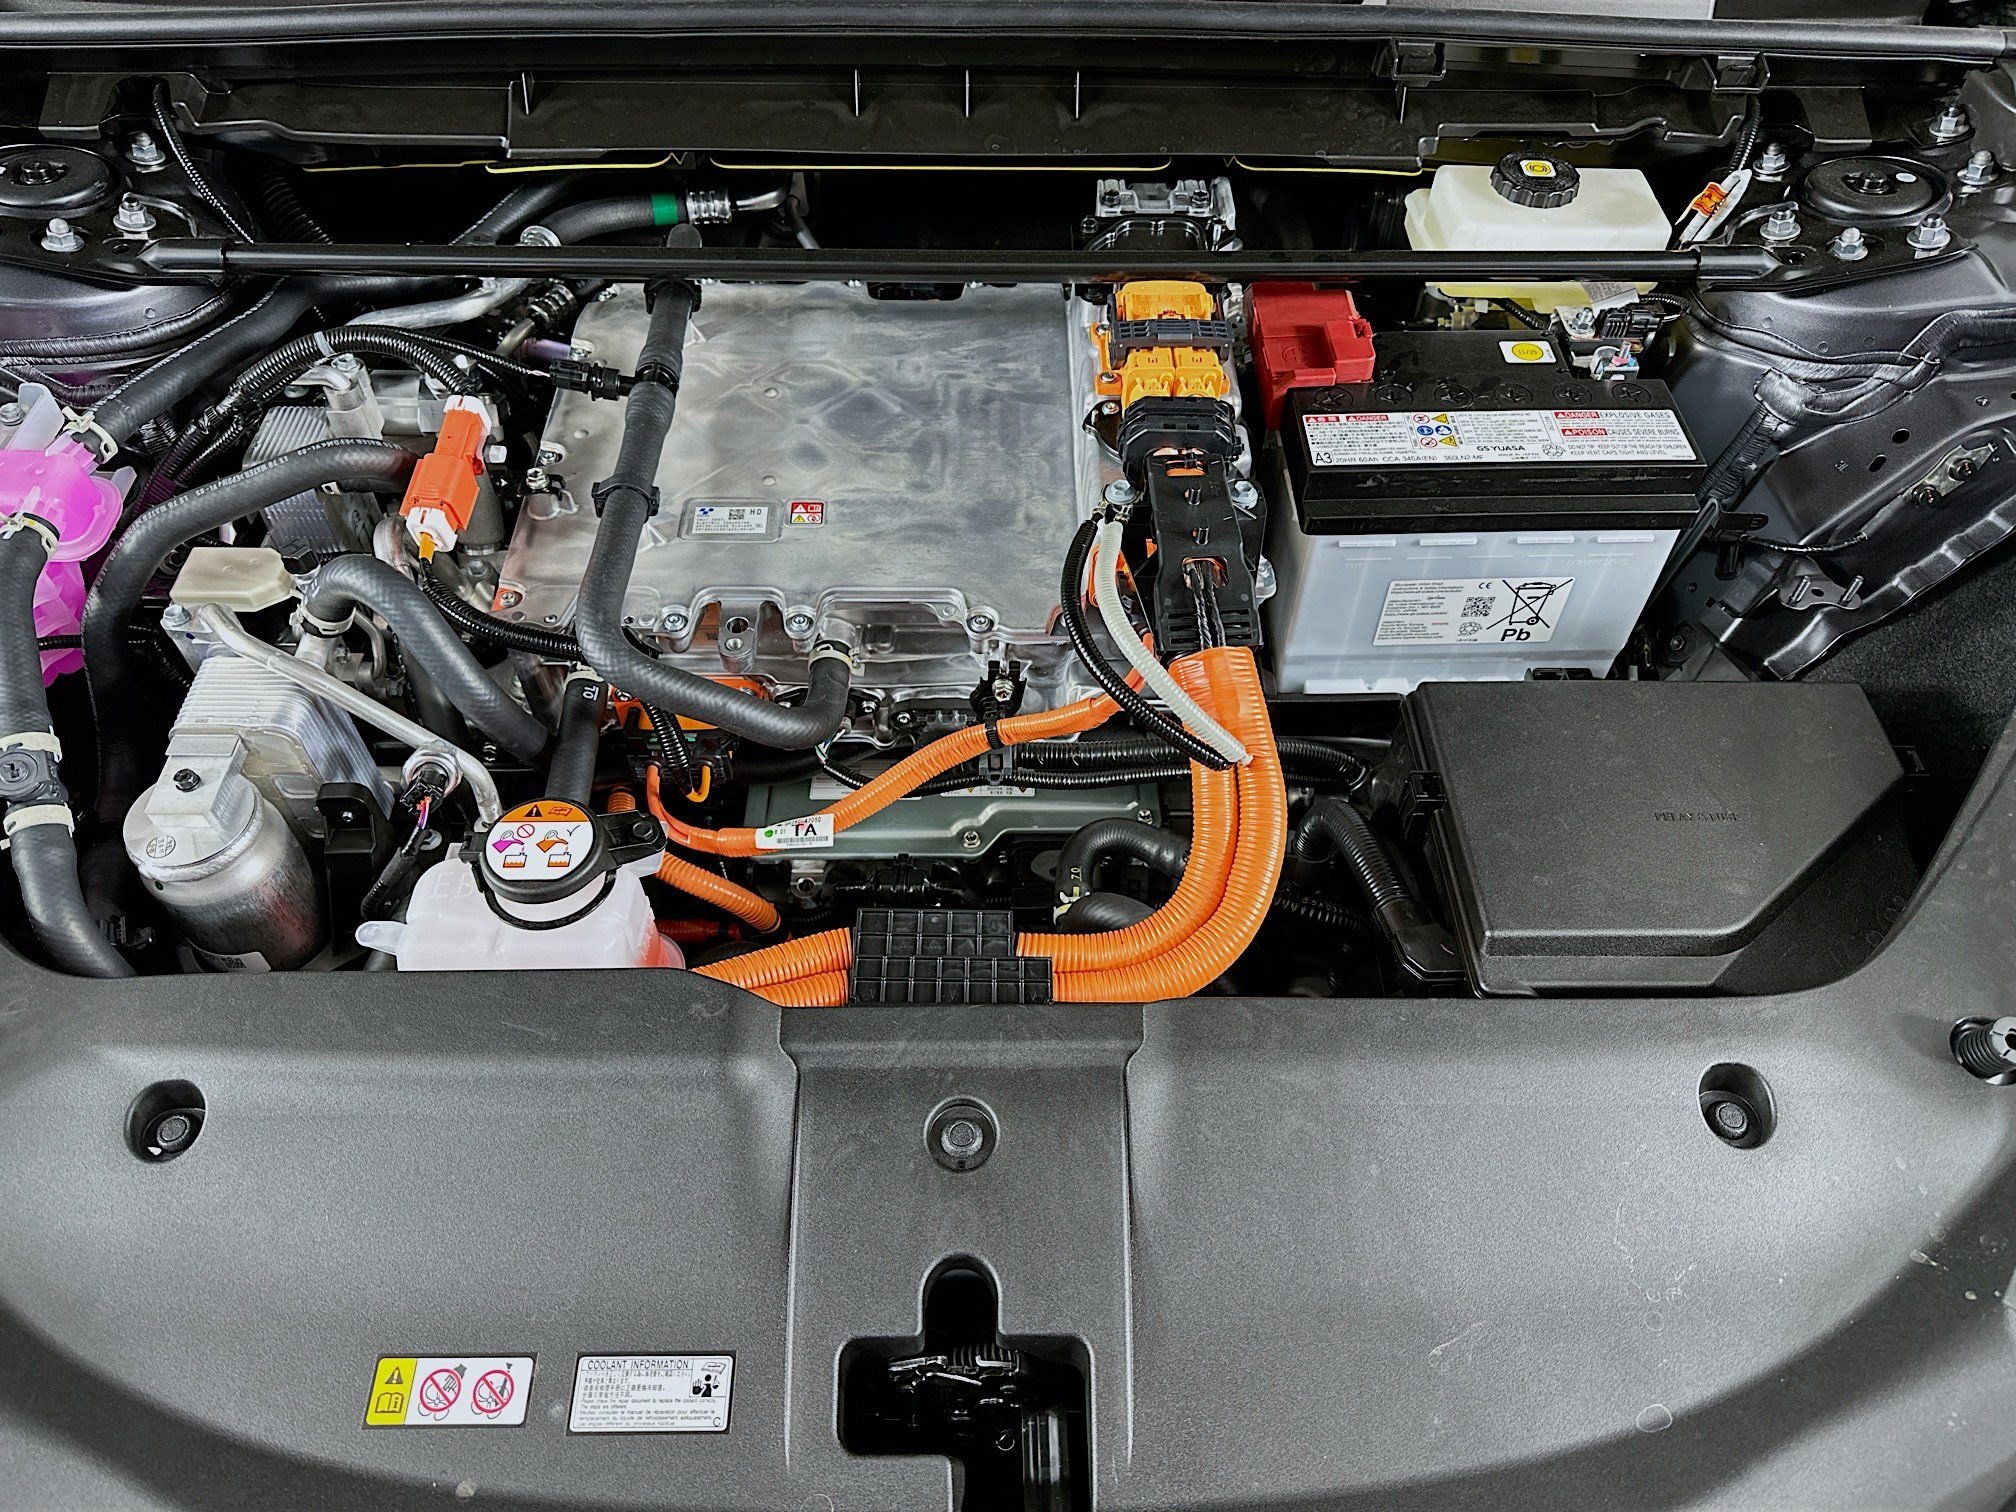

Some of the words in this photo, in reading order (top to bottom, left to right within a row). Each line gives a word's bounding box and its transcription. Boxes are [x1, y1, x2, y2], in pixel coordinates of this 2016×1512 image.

[1572, 428, 1606, 436] POISON
[1607, 428, 1633, 436] CAUSES
[1633, 428, 1658, 436] SEVERE
[1659, 428, 1680, 436] BURNS
[1315, 452, 1332, 464] A3
[1478, 582, 1492, 590] CE
[1500, 628, 1531, 642] Pb
[794, 823, 818, 836] TA
[588, 1360, 628, 1369] COOLANT
[630, 1360, 689, 1369] INFORMATION
[712, 1416, 721, 1427] C
